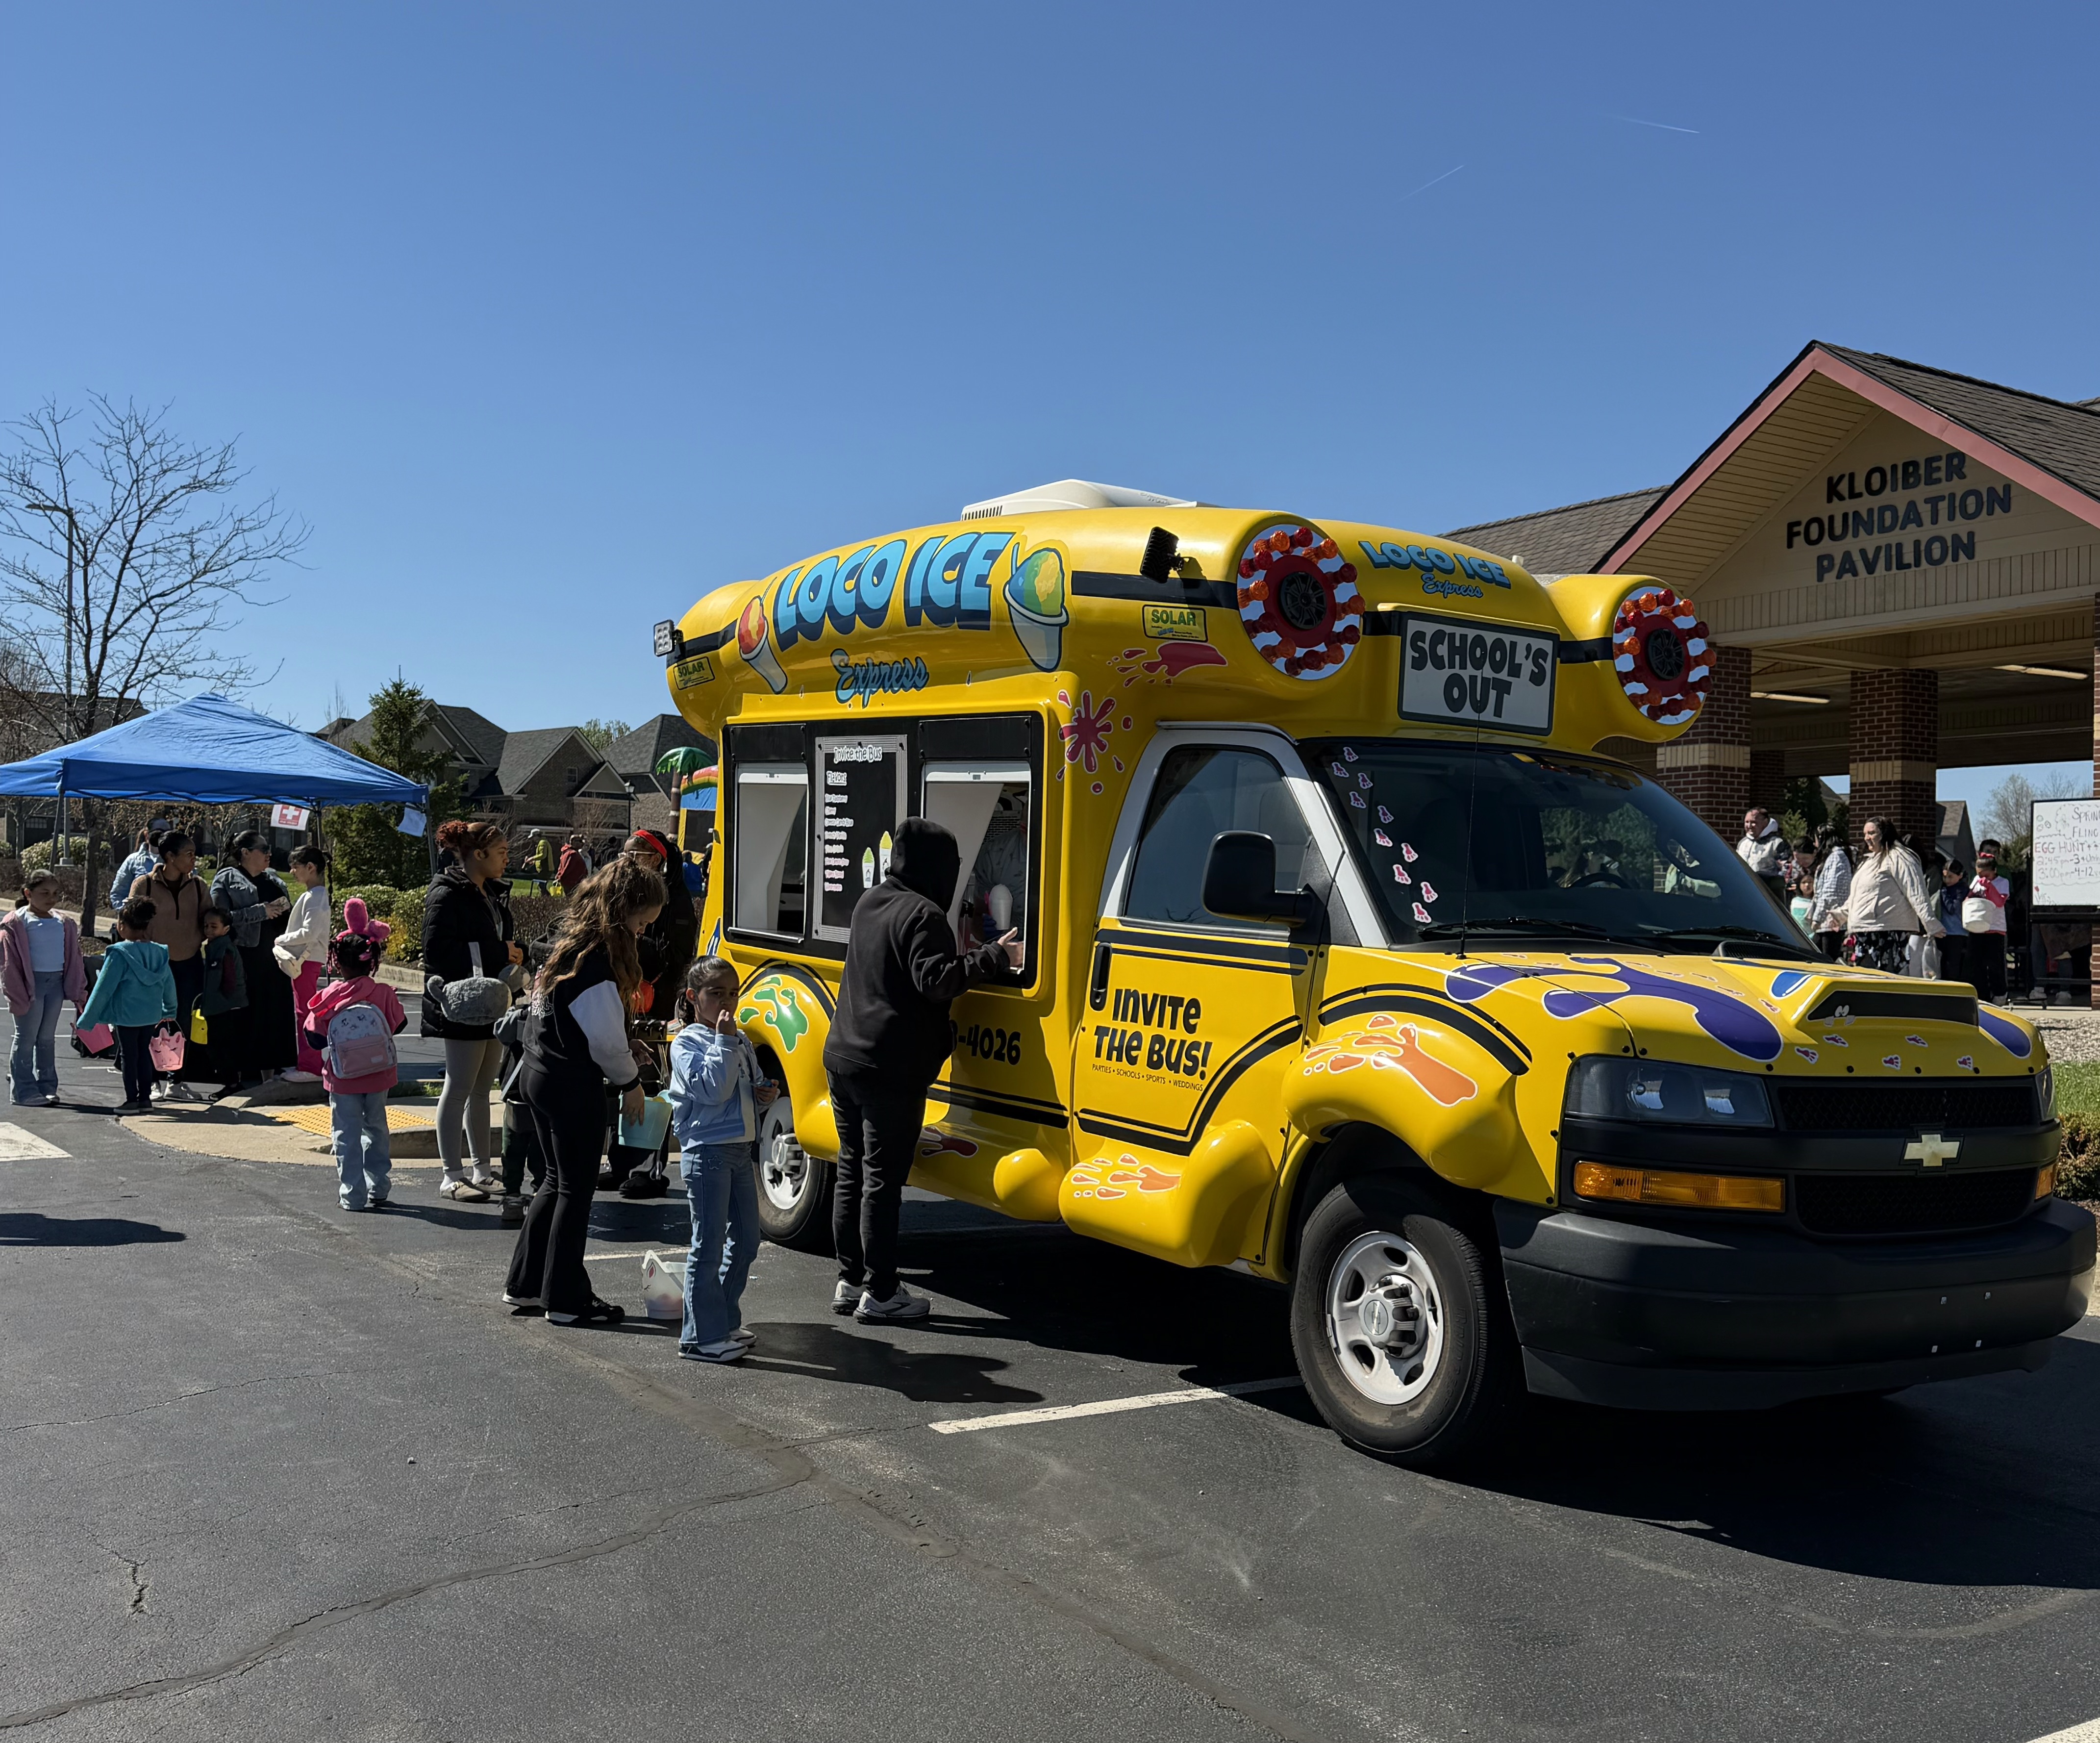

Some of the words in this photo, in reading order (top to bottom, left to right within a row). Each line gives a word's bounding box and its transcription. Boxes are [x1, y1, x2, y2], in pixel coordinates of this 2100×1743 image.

[1826, 452, 1967, 504] KLOIBER
[1786, 483, 2011, 549] FOUNDATION
[1358, 541, 1455, 575] LOCO
[1453, 553, 1511, 589] ICE
[1816, 530, 1975, 582] PAVILION
[773, 539, 907, 653] LOCO
[903, 532, 1017, 631] ICE
[1421, 573, 1484, 599] Express
[1151, 609, 1197, 626] SOLAR
[677, 661, 705, 678] SOLAR
[830, 649, 929, 709] Express
[1409, 629, 1549, 686] SCHOOL'S
[1443, 673, 1513, 718] OUT
[855, 747, 867, 761] the
[868, 746, 882, 761] Bus
[2035, 842, 2055, 854] EGG
[2059, 841, 2085, 853] HUNT
[1092, 1063, 1112, 1073] PARTIES
[1117, 1068, 1141, 1079] SCHOOLS
[1146, 1074, 1166, 1084] SPORTS
[1173, 1079, 1203, 1091] WEDDINGS
